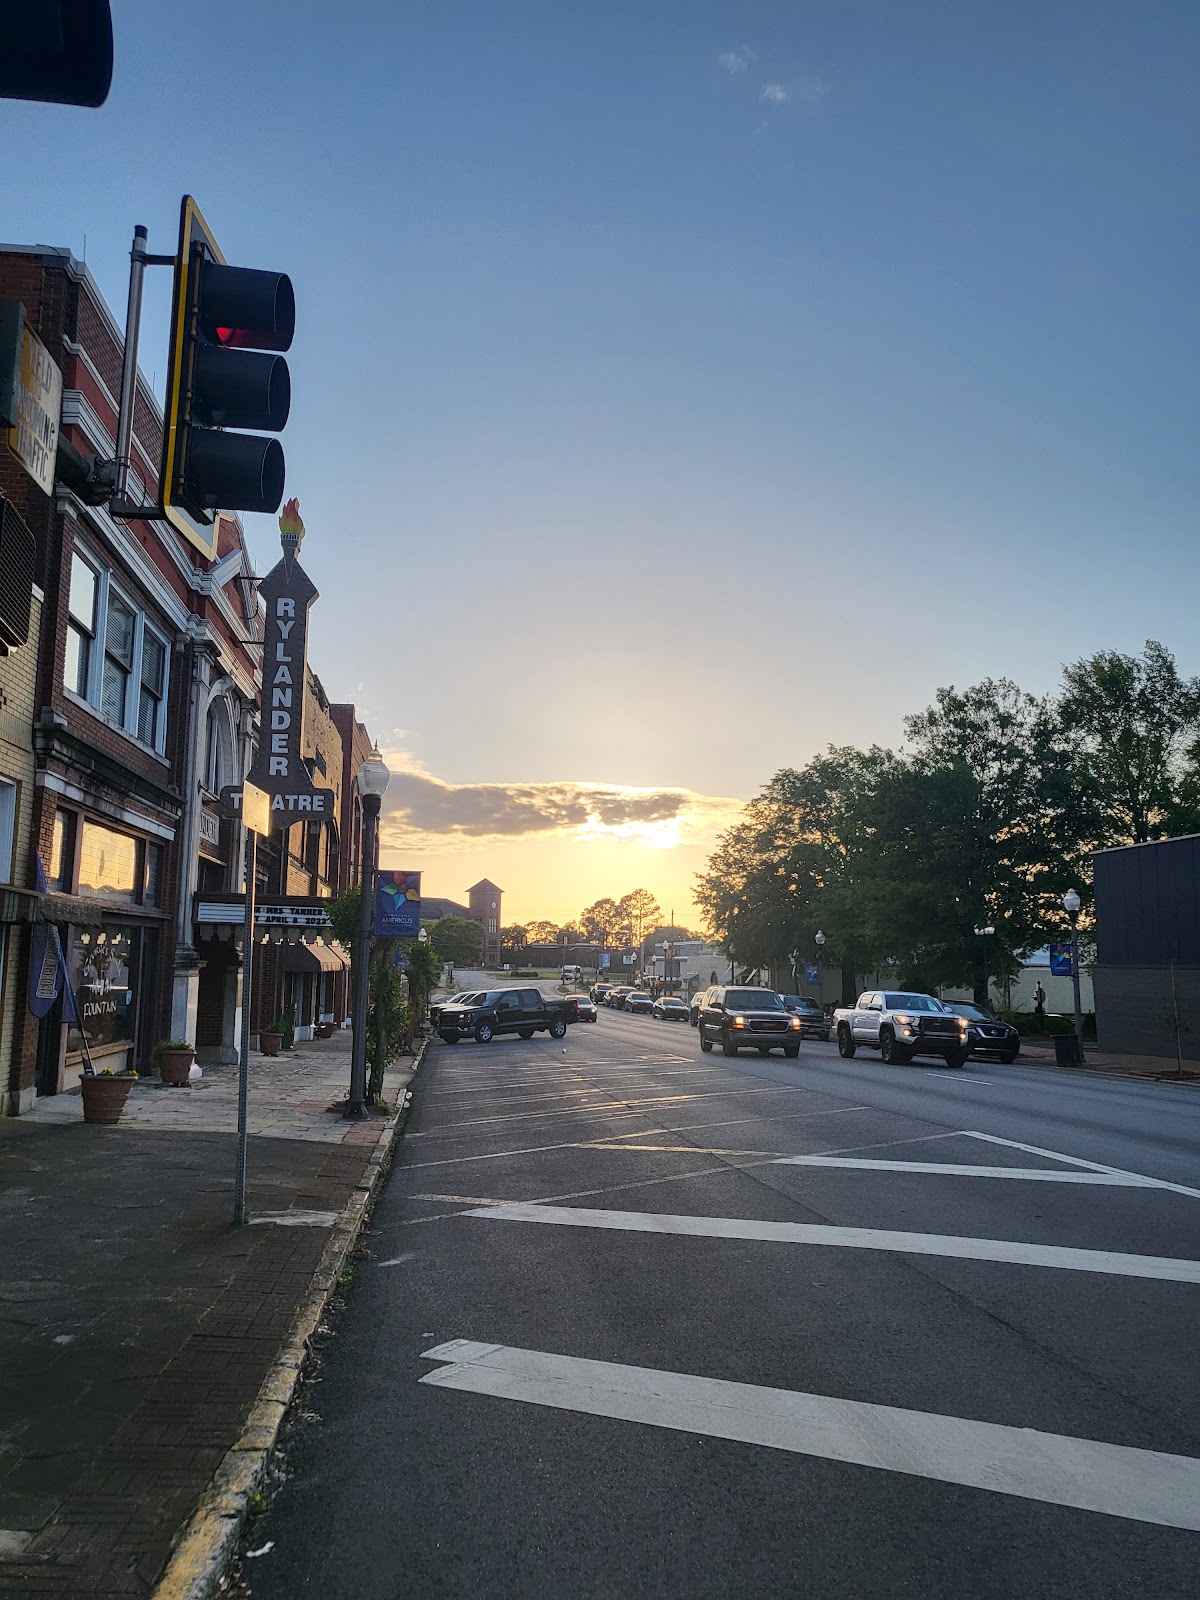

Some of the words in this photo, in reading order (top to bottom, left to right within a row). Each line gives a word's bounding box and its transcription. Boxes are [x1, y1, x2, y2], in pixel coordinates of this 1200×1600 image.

[29, 335, 53, 394] YIELD
[18, 385, 56, 453] NCOMING
[18, 420, 49, 483] TRAFFIC
[269, 597, 295, 777] RYLANDER
[230, 793, 325, 812] TATRE
[265, 915, 289, 924] APRIL
[305, 917, 327, 925] 2023
